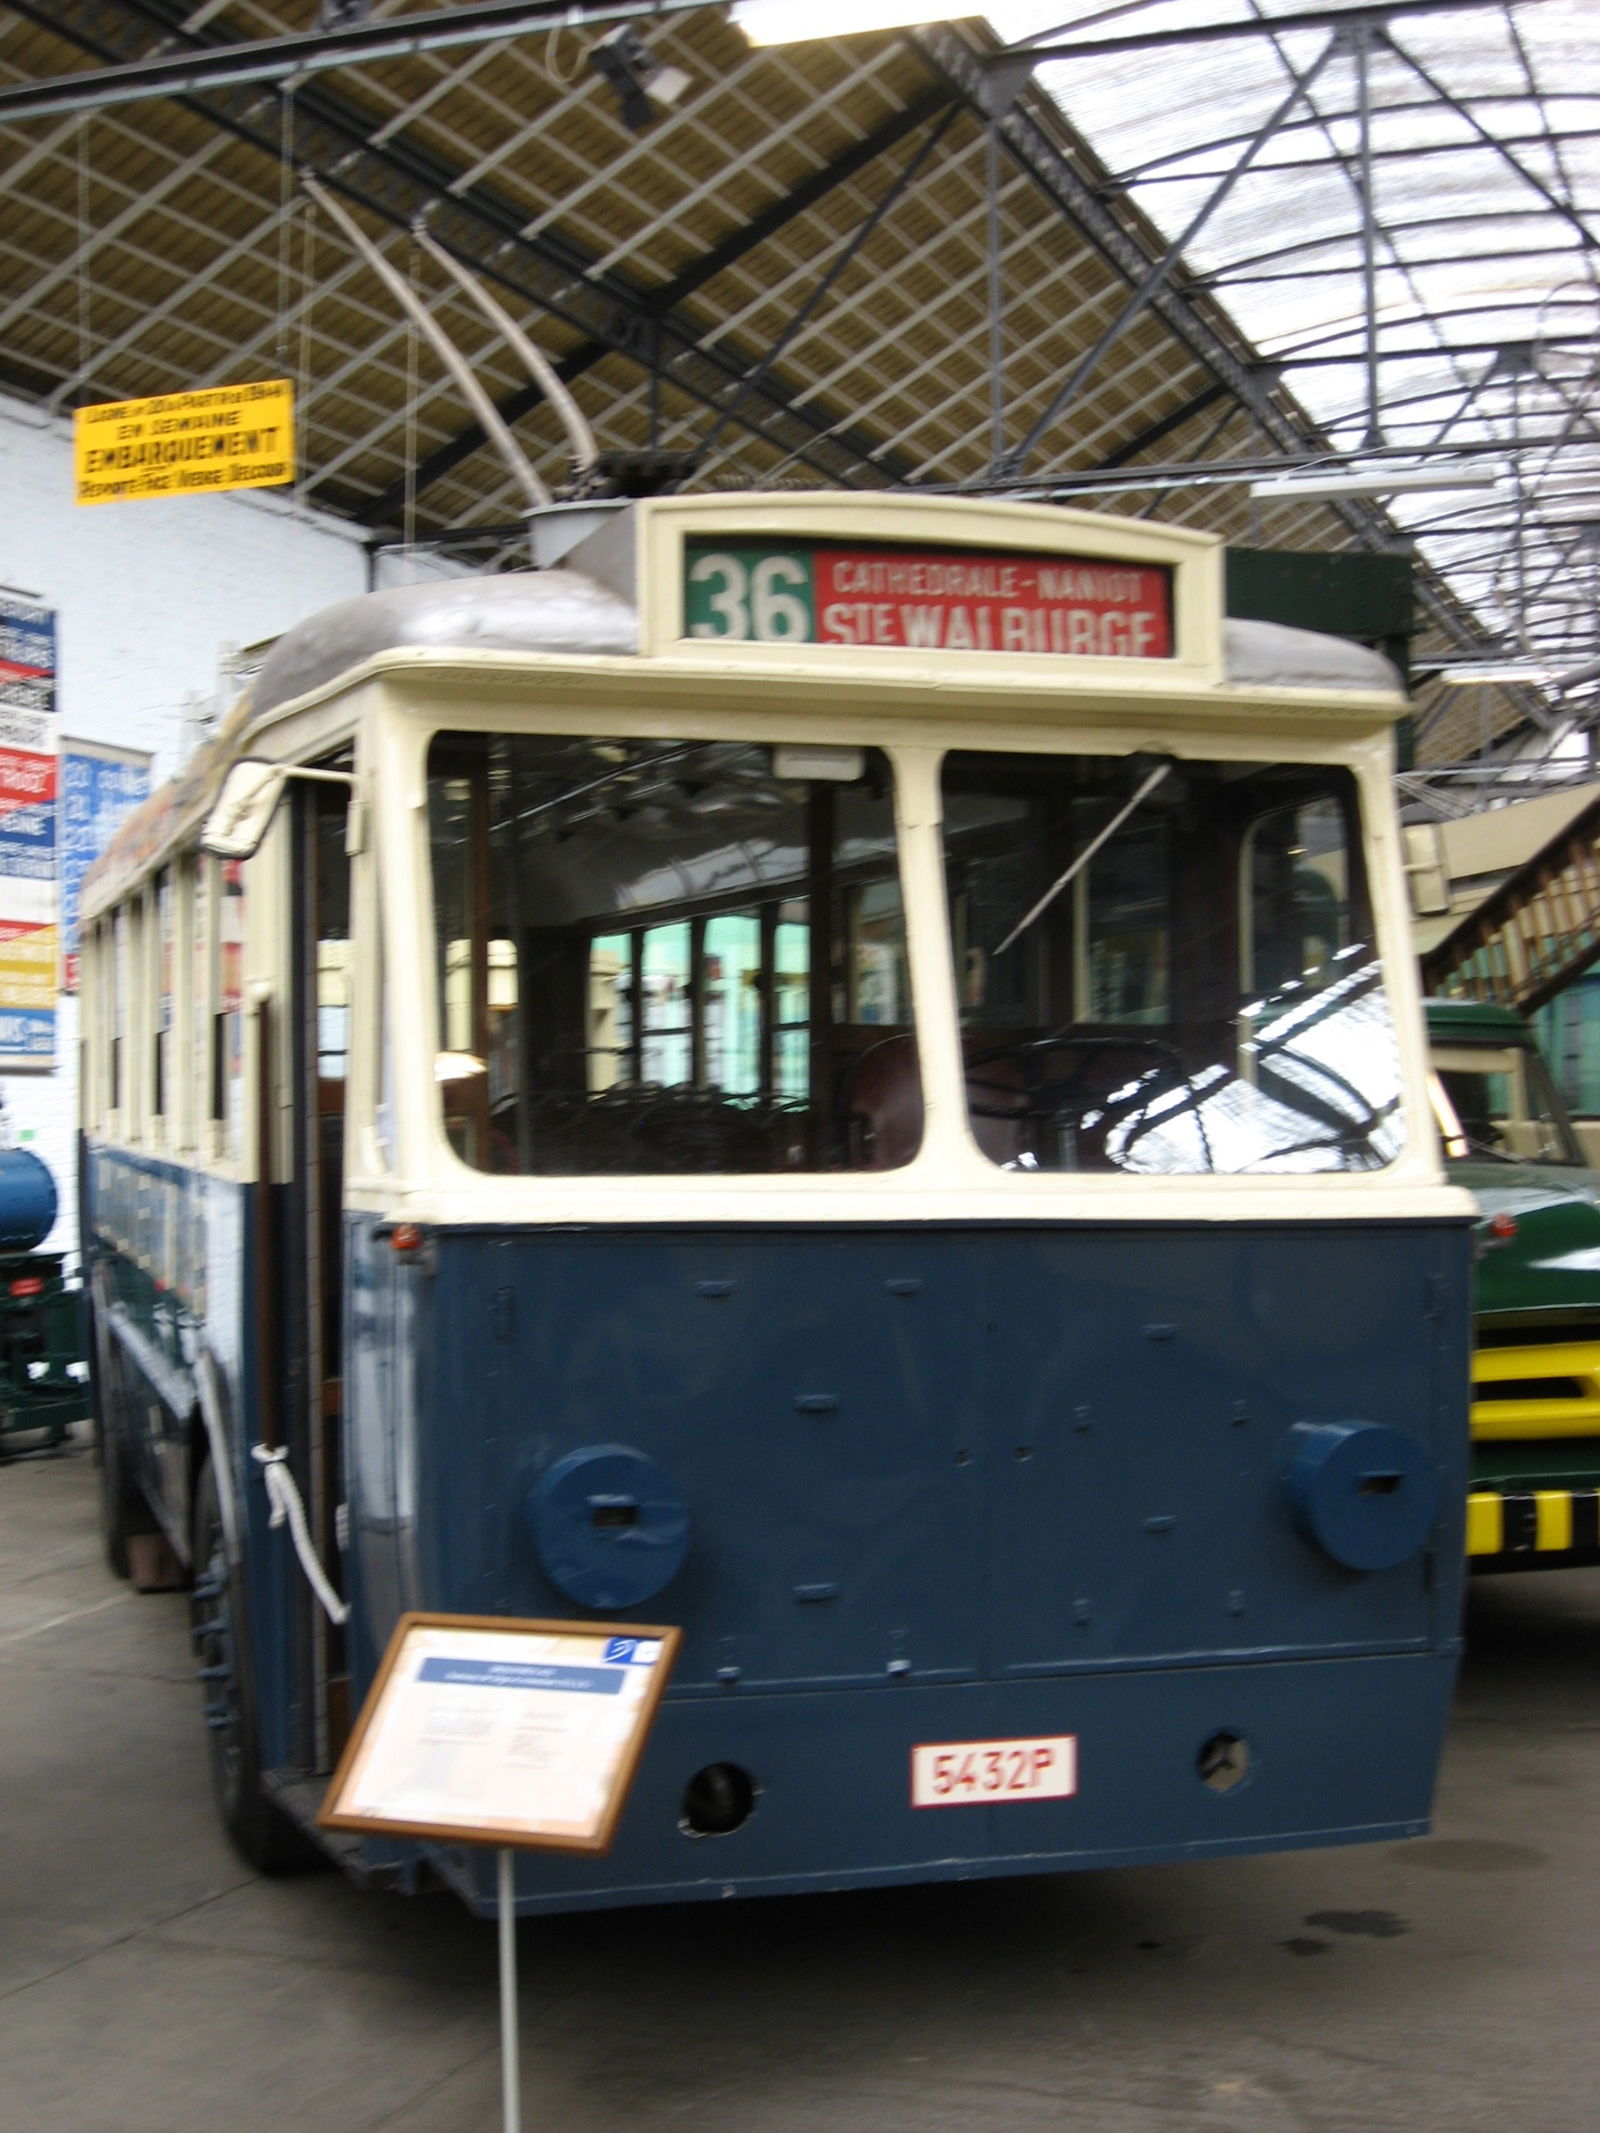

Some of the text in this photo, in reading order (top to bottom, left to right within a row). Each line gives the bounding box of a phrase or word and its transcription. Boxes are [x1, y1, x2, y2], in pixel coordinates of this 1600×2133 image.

[116, 410, 241, 440] EN SEMAINE
[85, 426, 281, 473] EMBARQUEMENT
[690, 553, 810, 642] 36
[823, 602, 897, 643] STE
[932, 1747, 1055, 1795] 5432P
